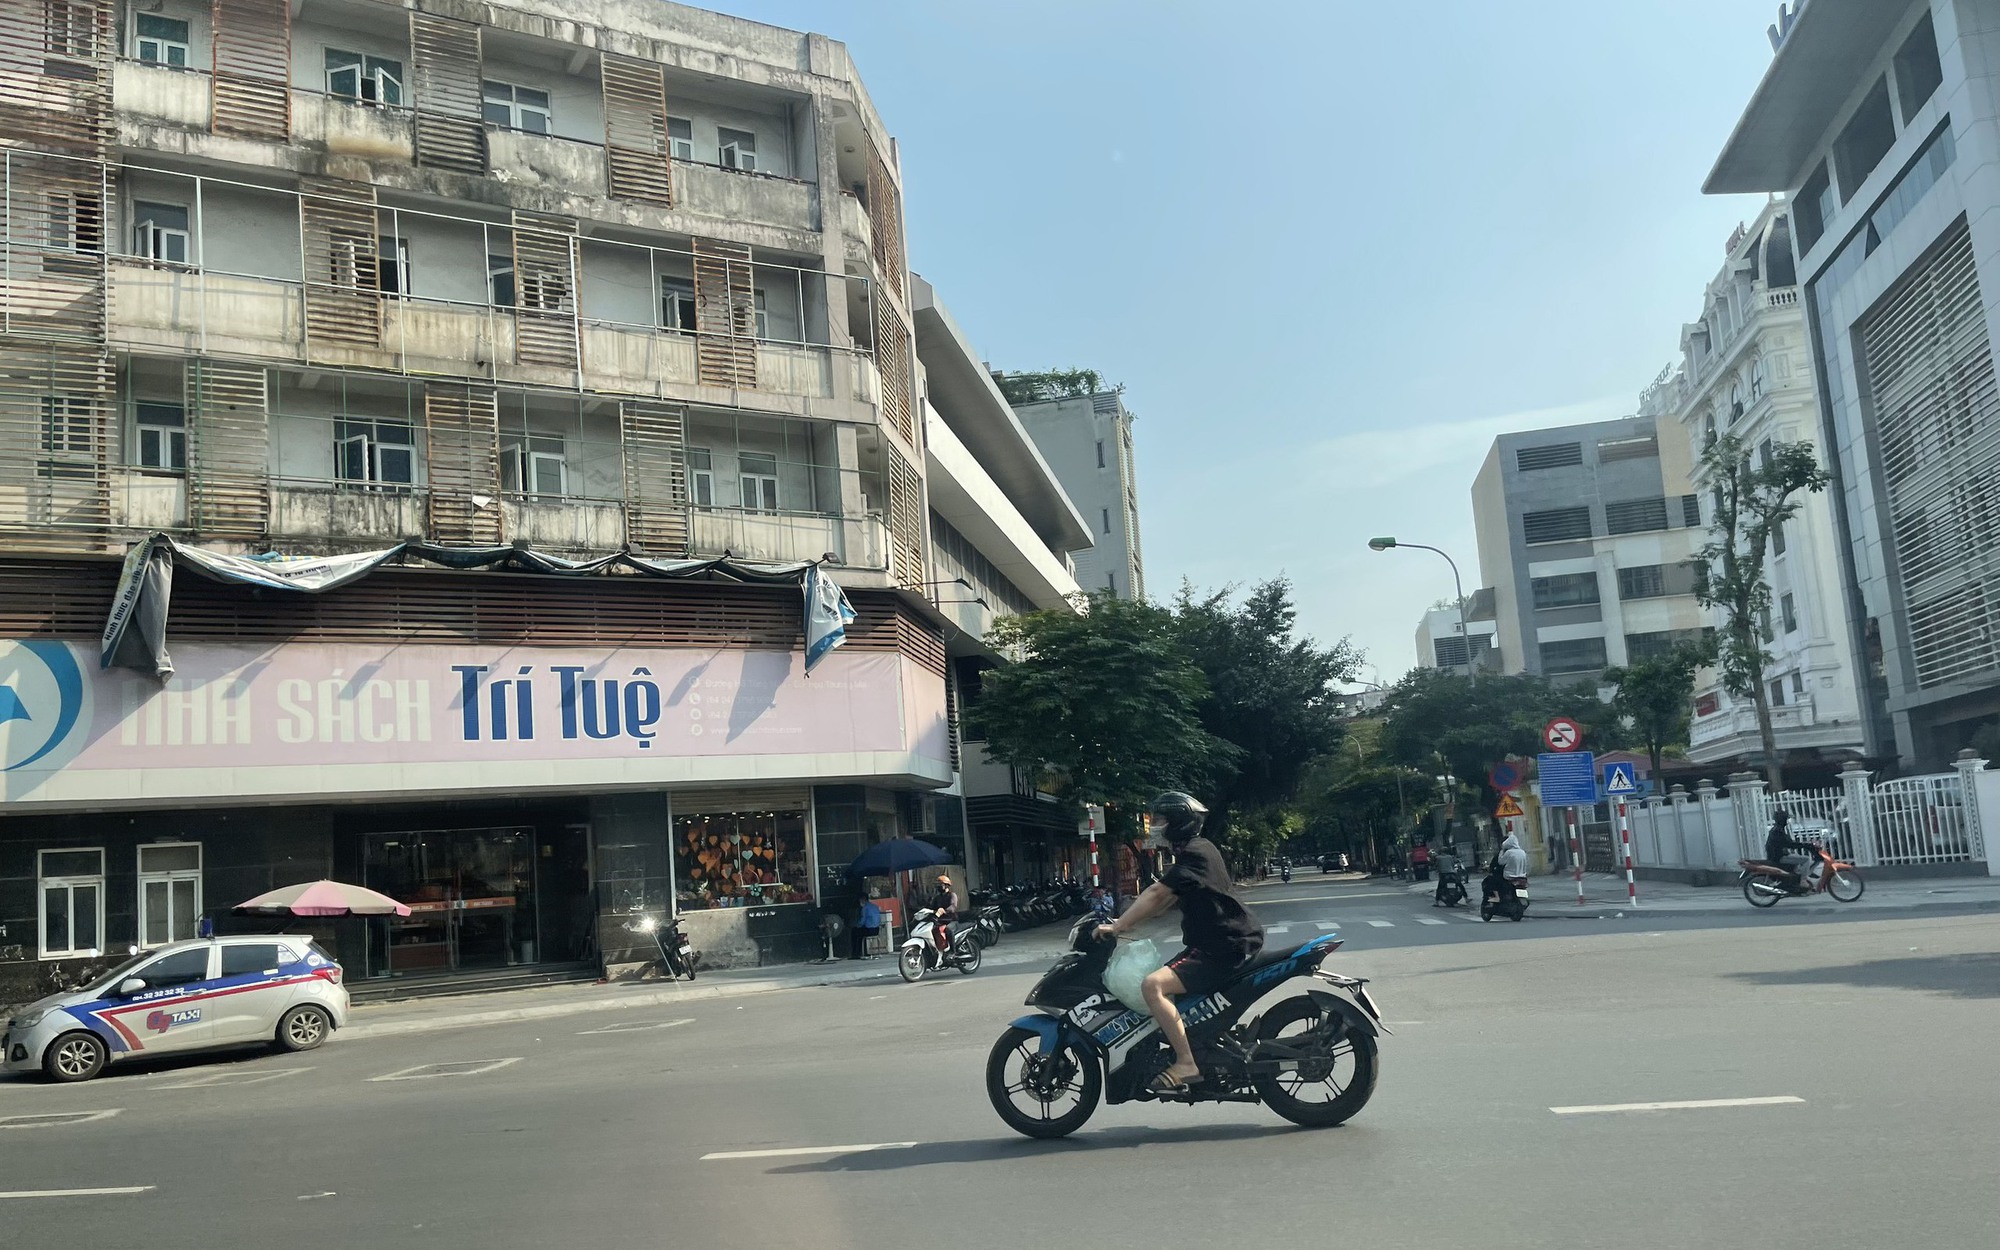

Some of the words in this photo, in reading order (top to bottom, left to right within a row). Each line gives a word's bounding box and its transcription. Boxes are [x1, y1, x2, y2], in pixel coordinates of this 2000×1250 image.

[121, 667, 251, 746] NHÀ
[277, 668, 432, 744] SÁCH
[451, 665, 534, 741] Trí
[550, 666, 661, 749] Tuệ
[172, 1010, 200, 1023] TAXI
